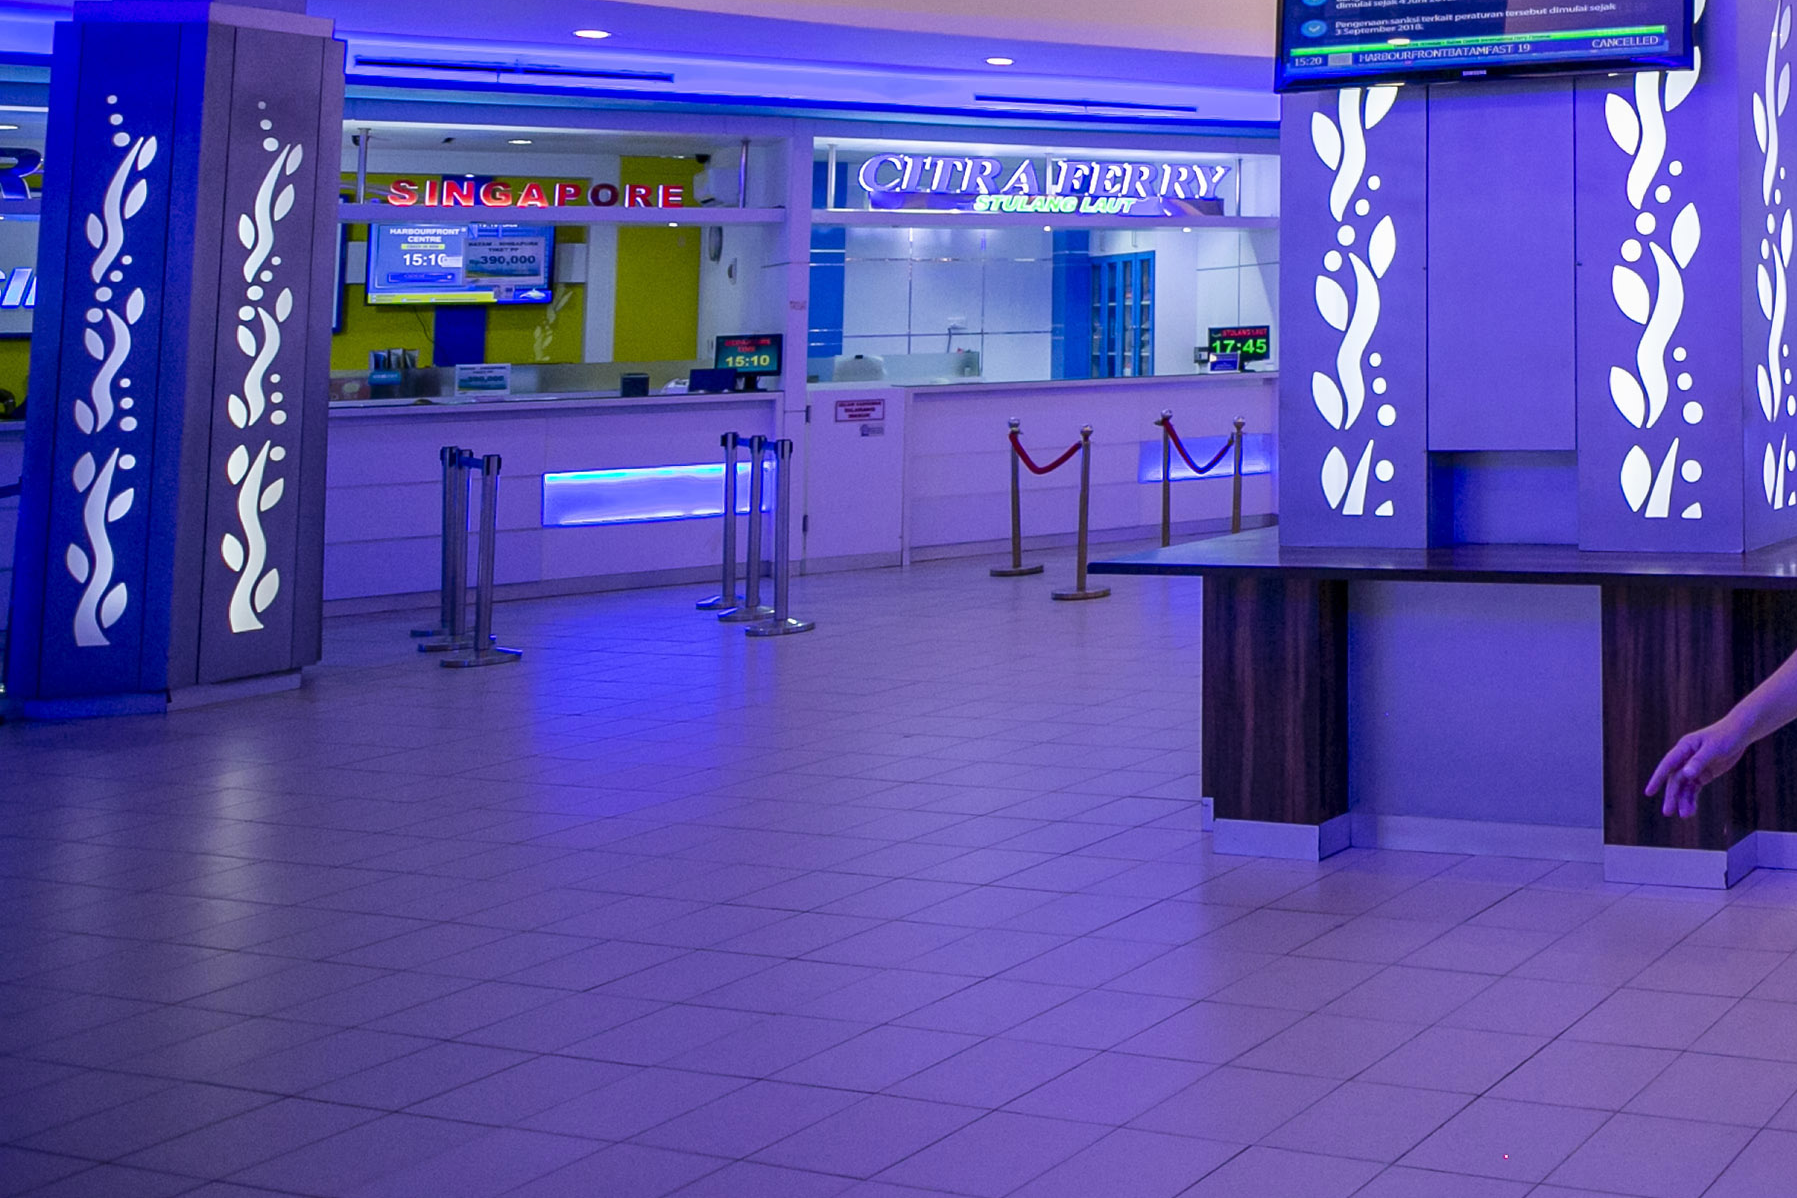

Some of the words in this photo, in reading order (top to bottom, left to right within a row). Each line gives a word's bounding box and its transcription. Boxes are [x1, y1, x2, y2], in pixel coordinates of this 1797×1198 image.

[1336, 1, 1371, 9] dimulai
[1374, 0, 1398, 8] sejak
[1335, 19, 1389, 30] Pengenaan
[1390, 16, 1420, 25] sanksi
[1421, 14, 1453, 23] terkait
[1455, 10, 1503, 22] peraturan
[1505, 7, 1547, 18] tersebut
[1549, 4, 1587, 15] dimulai
[1589, 2, 1616, 12] sejak
[1343, 25, 1396, 36] September
[1294, 56, 1322, 66] 15:20
[1517, 44, 1531, 53] 19
[1592, 35, 1659, 49] CANCELLED
[858, 153, 1039, 196] CITRA
[1056, 160, 1231, 200] FERRY
[387, 179, 684, 209] SINGAPORE
[973, 193, 1078, 214] STULANG
[1080, 196, 1136, 215] LAUT
[1211, 338, 1267, 354] 17:45
[725, 354, 770, 368] 15:10
